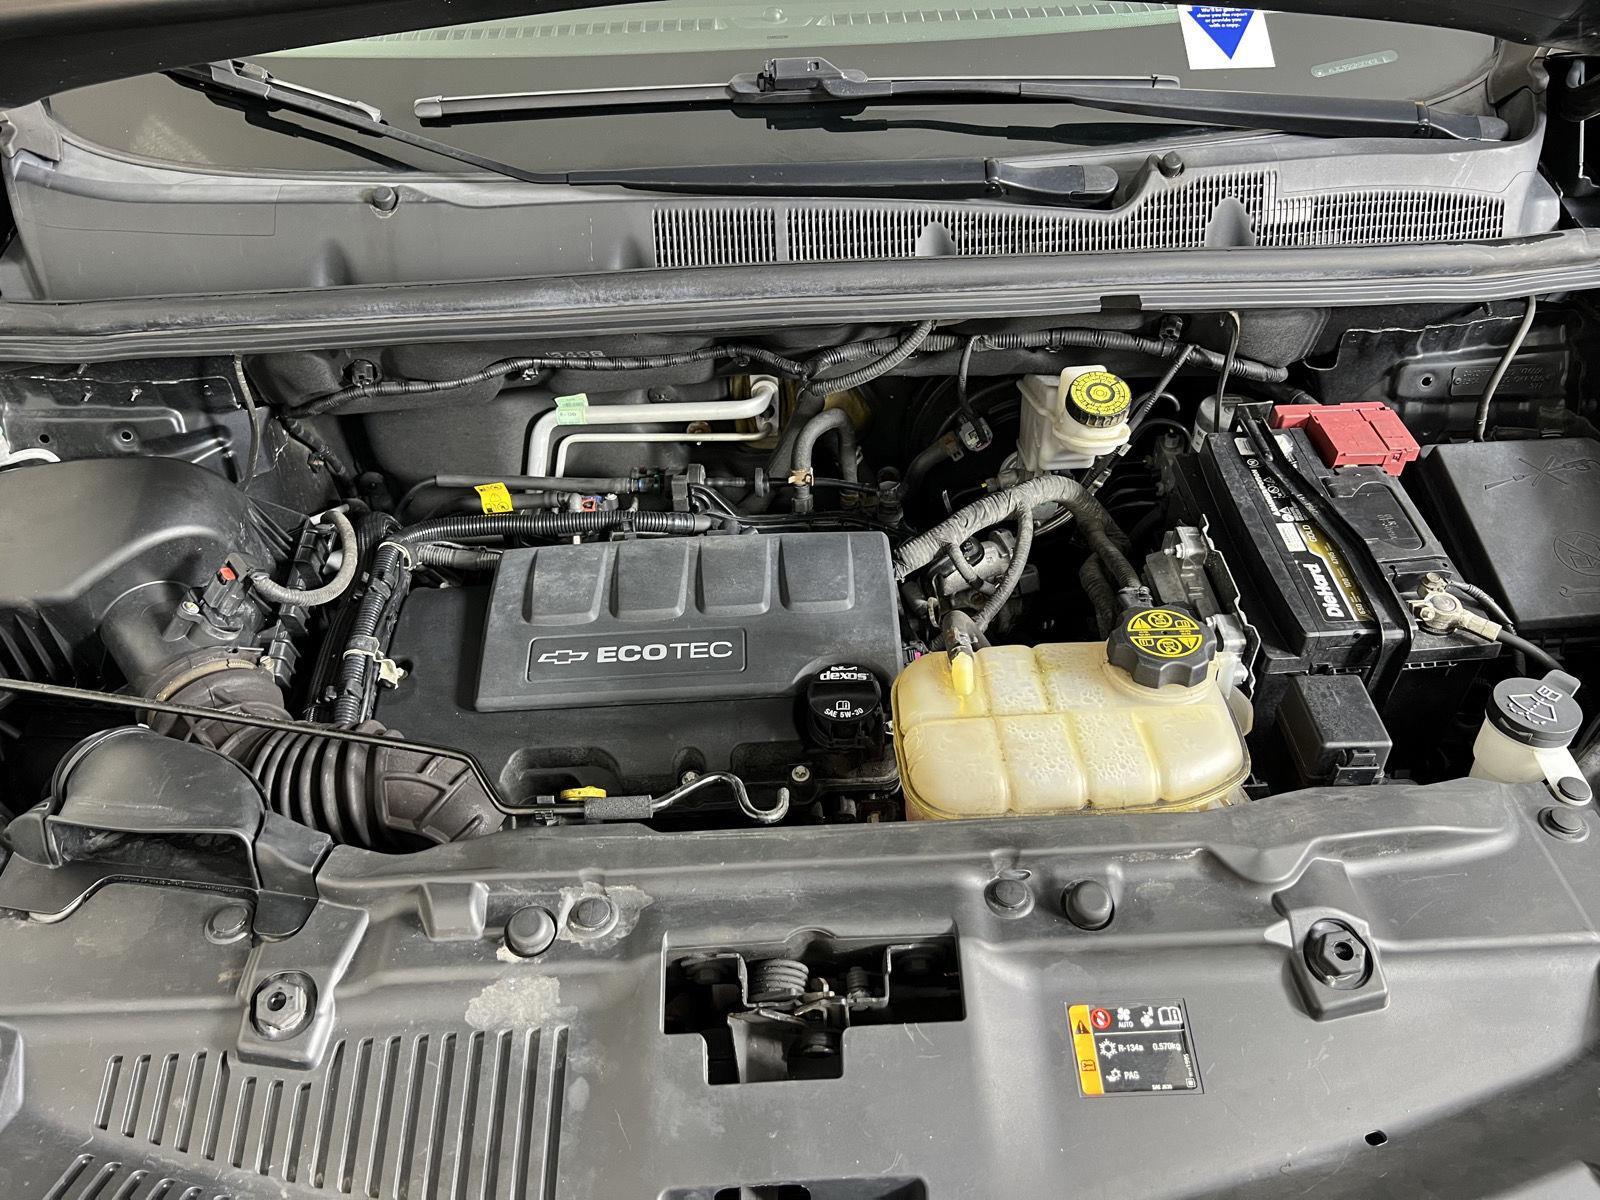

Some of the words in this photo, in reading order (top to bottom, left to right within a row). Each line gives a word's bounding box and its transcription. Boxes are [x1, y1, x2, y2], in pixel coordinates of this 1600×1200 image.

[1302, 524, 1318, 543] GOLD
[1302, 563, 1345, 618] DieHard
[596, 641, 733, 663] ECOTEC
[820, 670, 868, 681] dexos
[823, 708, 838, 718] SAE
[839, 707, 864, 718] 5W-30
[1118, 1044, 1144, 1052] R-134a
[1152, 1042, 1182, 1052] 0.570kg
[1123, 1071, 1140, 1080] PAG
